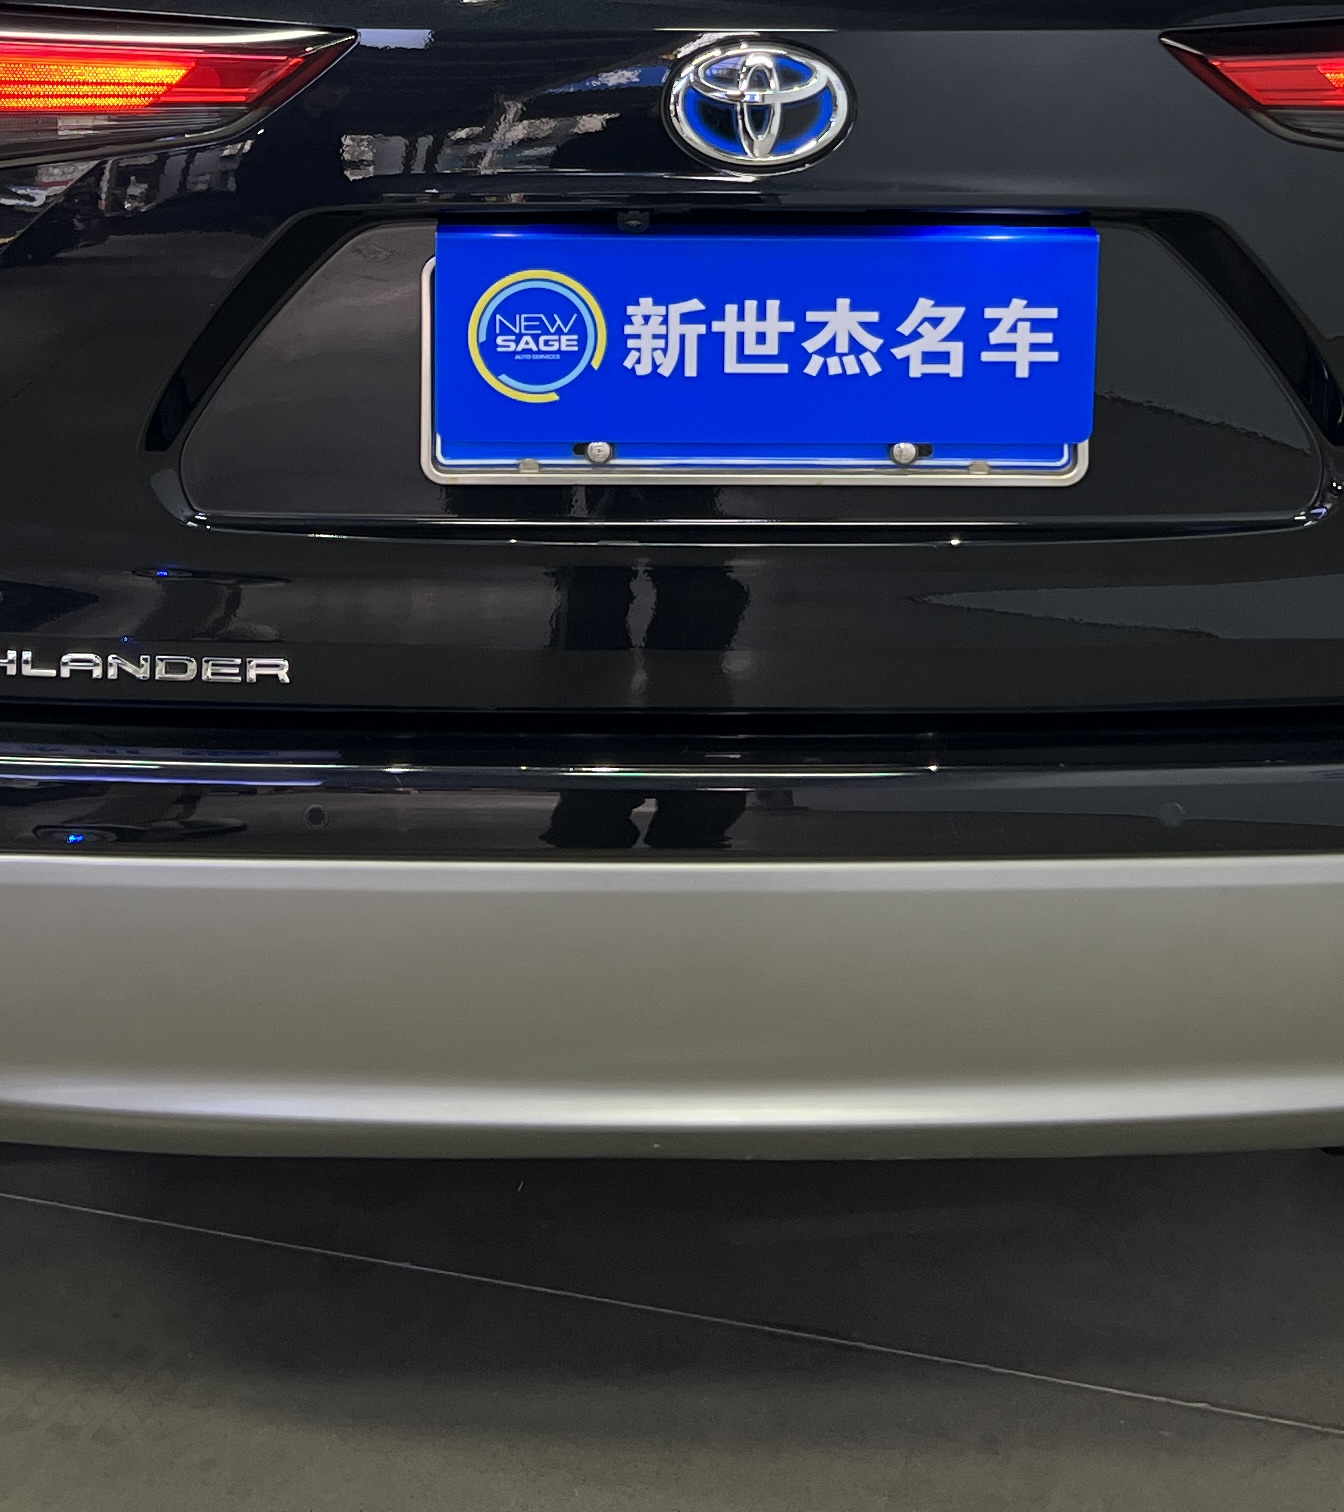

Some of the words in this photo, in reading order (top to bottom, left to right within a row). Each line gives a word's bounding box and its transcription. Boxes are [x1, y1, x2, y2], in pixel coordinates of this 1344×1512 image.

[495, 313, 578, 334] NEW
[495, 335, 579, 352] SAGE
[622, 296, 1060, 379] 新世杰名车
